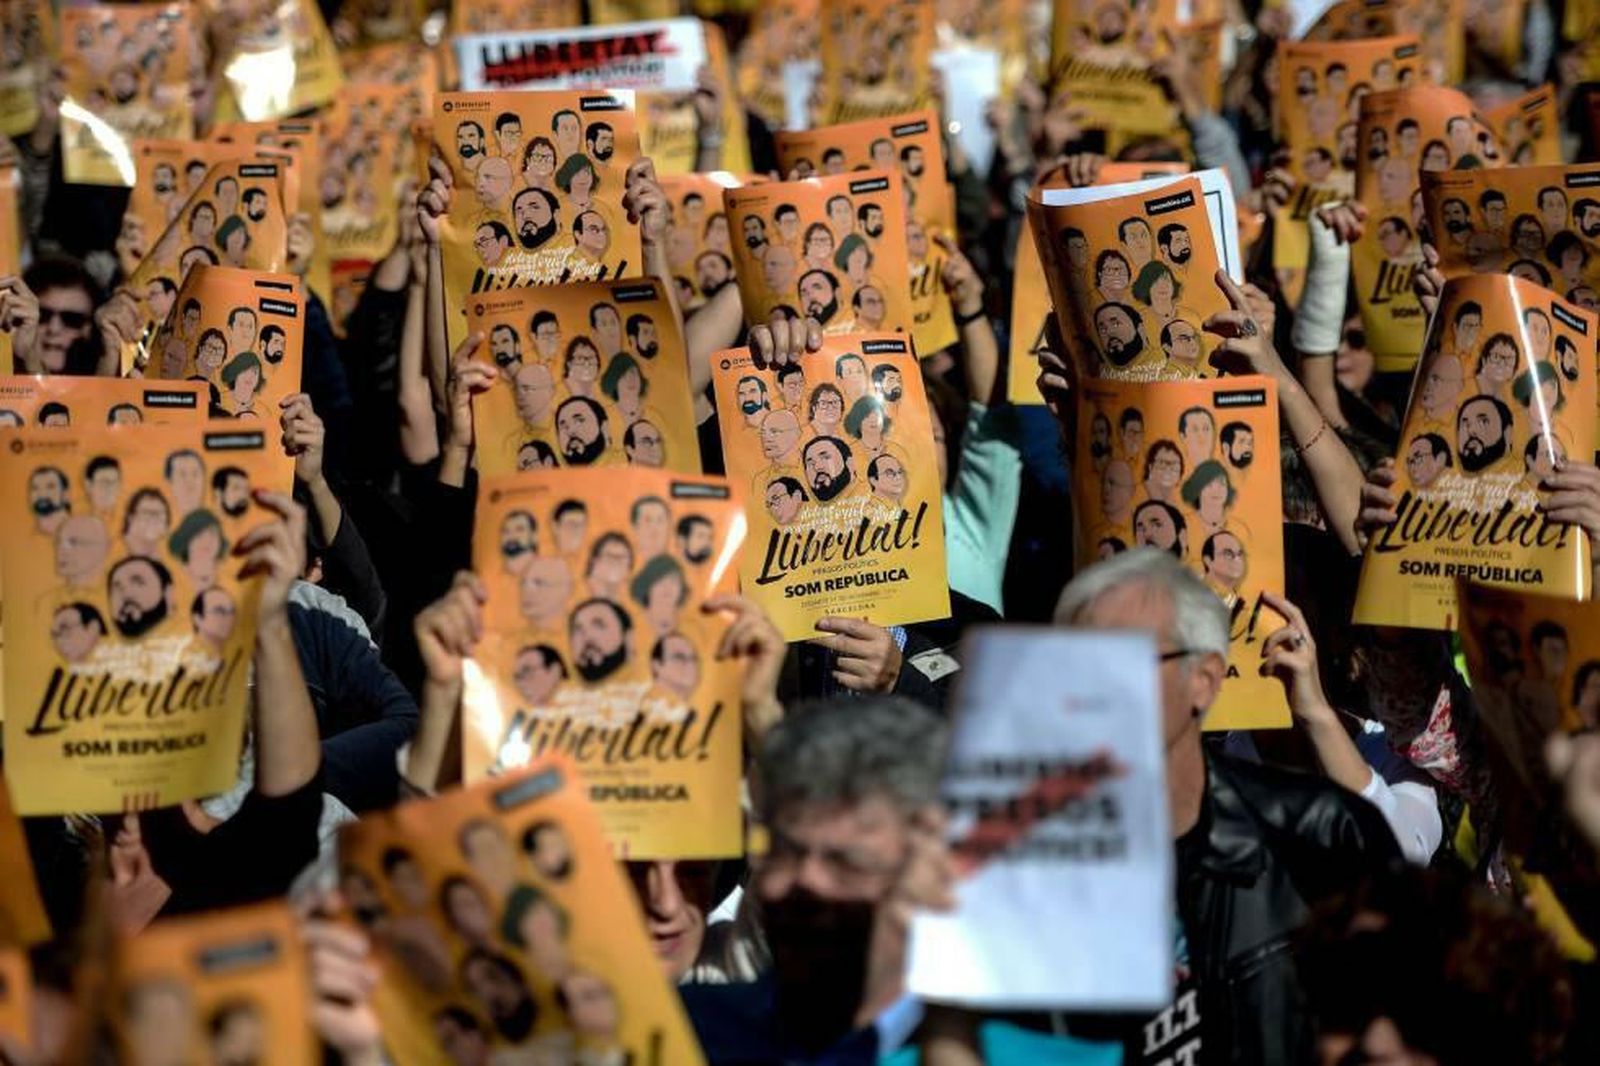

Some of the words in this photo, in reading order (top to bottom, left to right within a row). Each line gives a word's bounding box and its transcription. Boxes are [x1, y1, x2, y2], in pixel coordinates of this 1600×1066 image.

[755, 501, 928, 585] Llibertat!
[784, 582, 821, 599] SOM
[824, 568, 910, 591] REPÚBLICA
[1399, 560, 1441, 576] SOM
[1444, 562, 1544, 584] REPÚBLICA
[62, 741, 112, 757] SOM
[590, 783, 689, 801] EPÚBLICA
